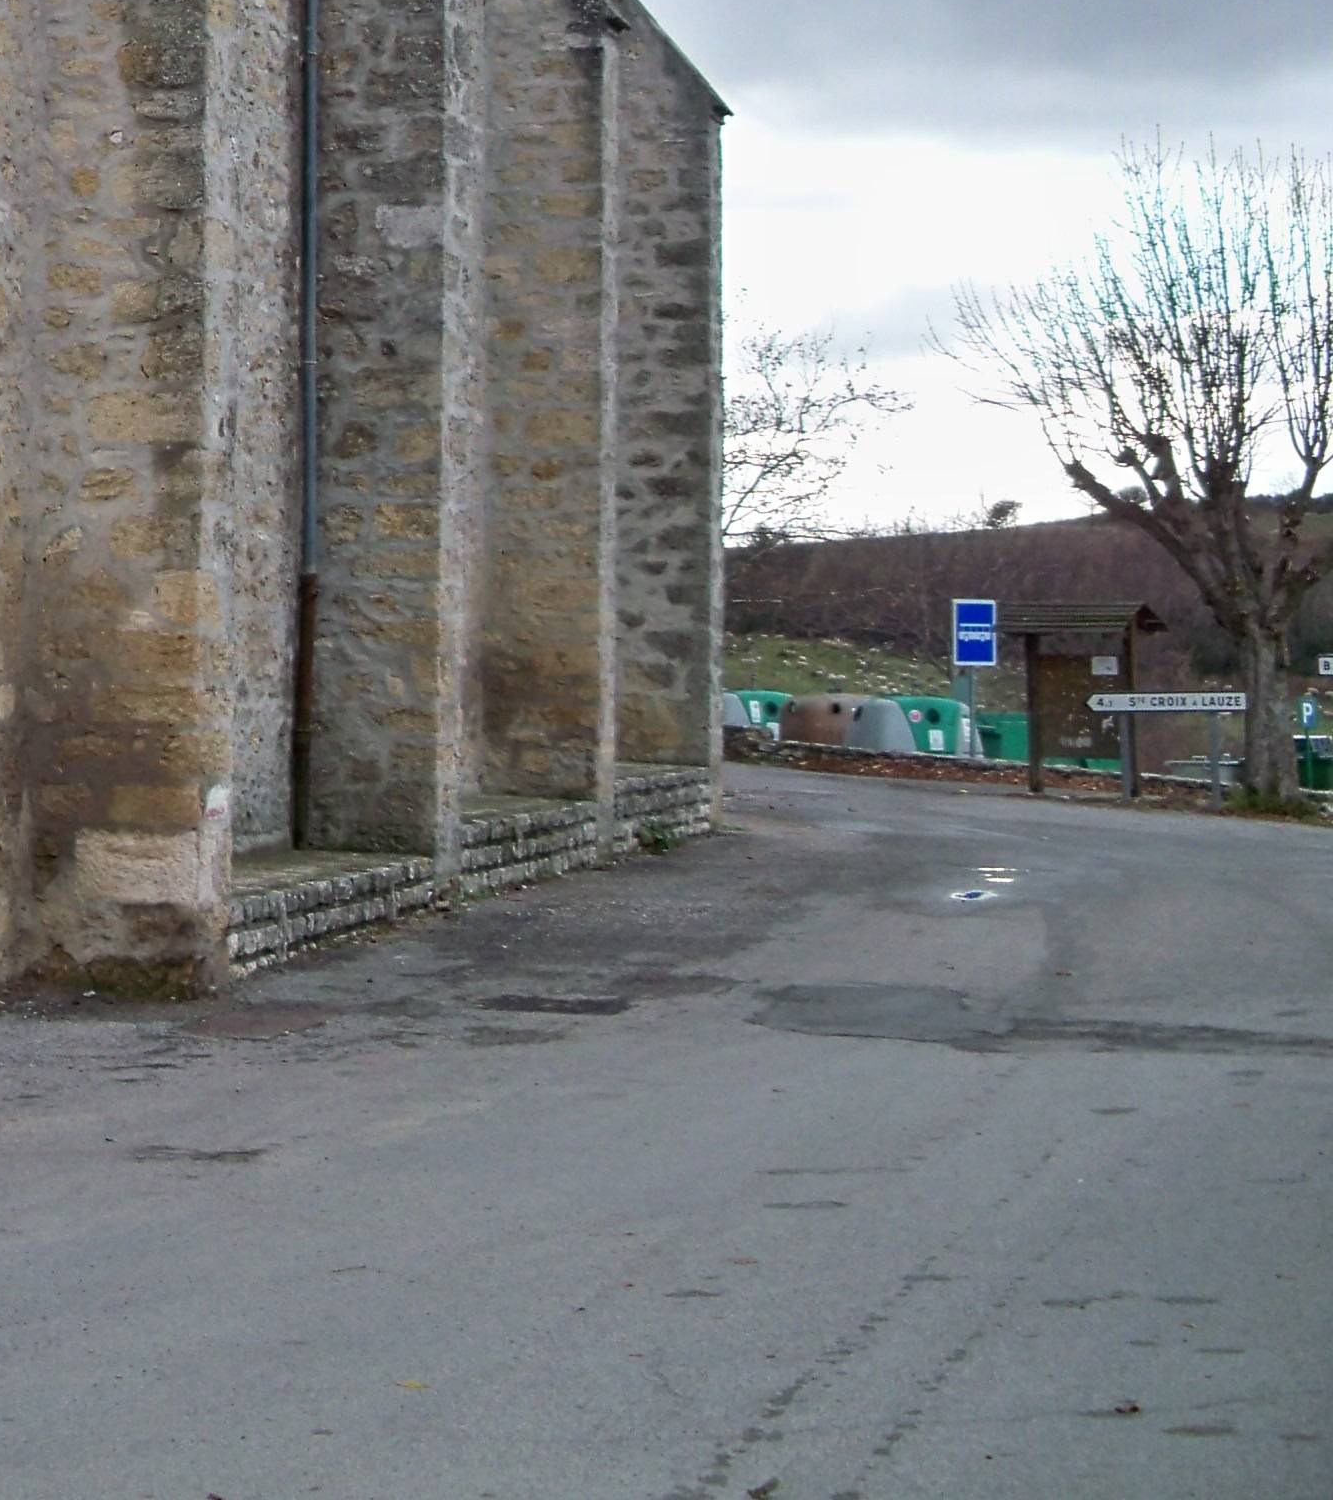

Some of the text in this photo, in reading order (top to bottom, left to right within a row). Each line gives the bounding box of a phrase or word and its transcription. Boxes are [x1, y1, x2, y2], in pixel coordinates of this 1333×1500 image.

[1150, 696, 1187, 707] CROIX
[1201, 696, 1242, 707] LAUZE
[1302, 702, 1312, 723] P
